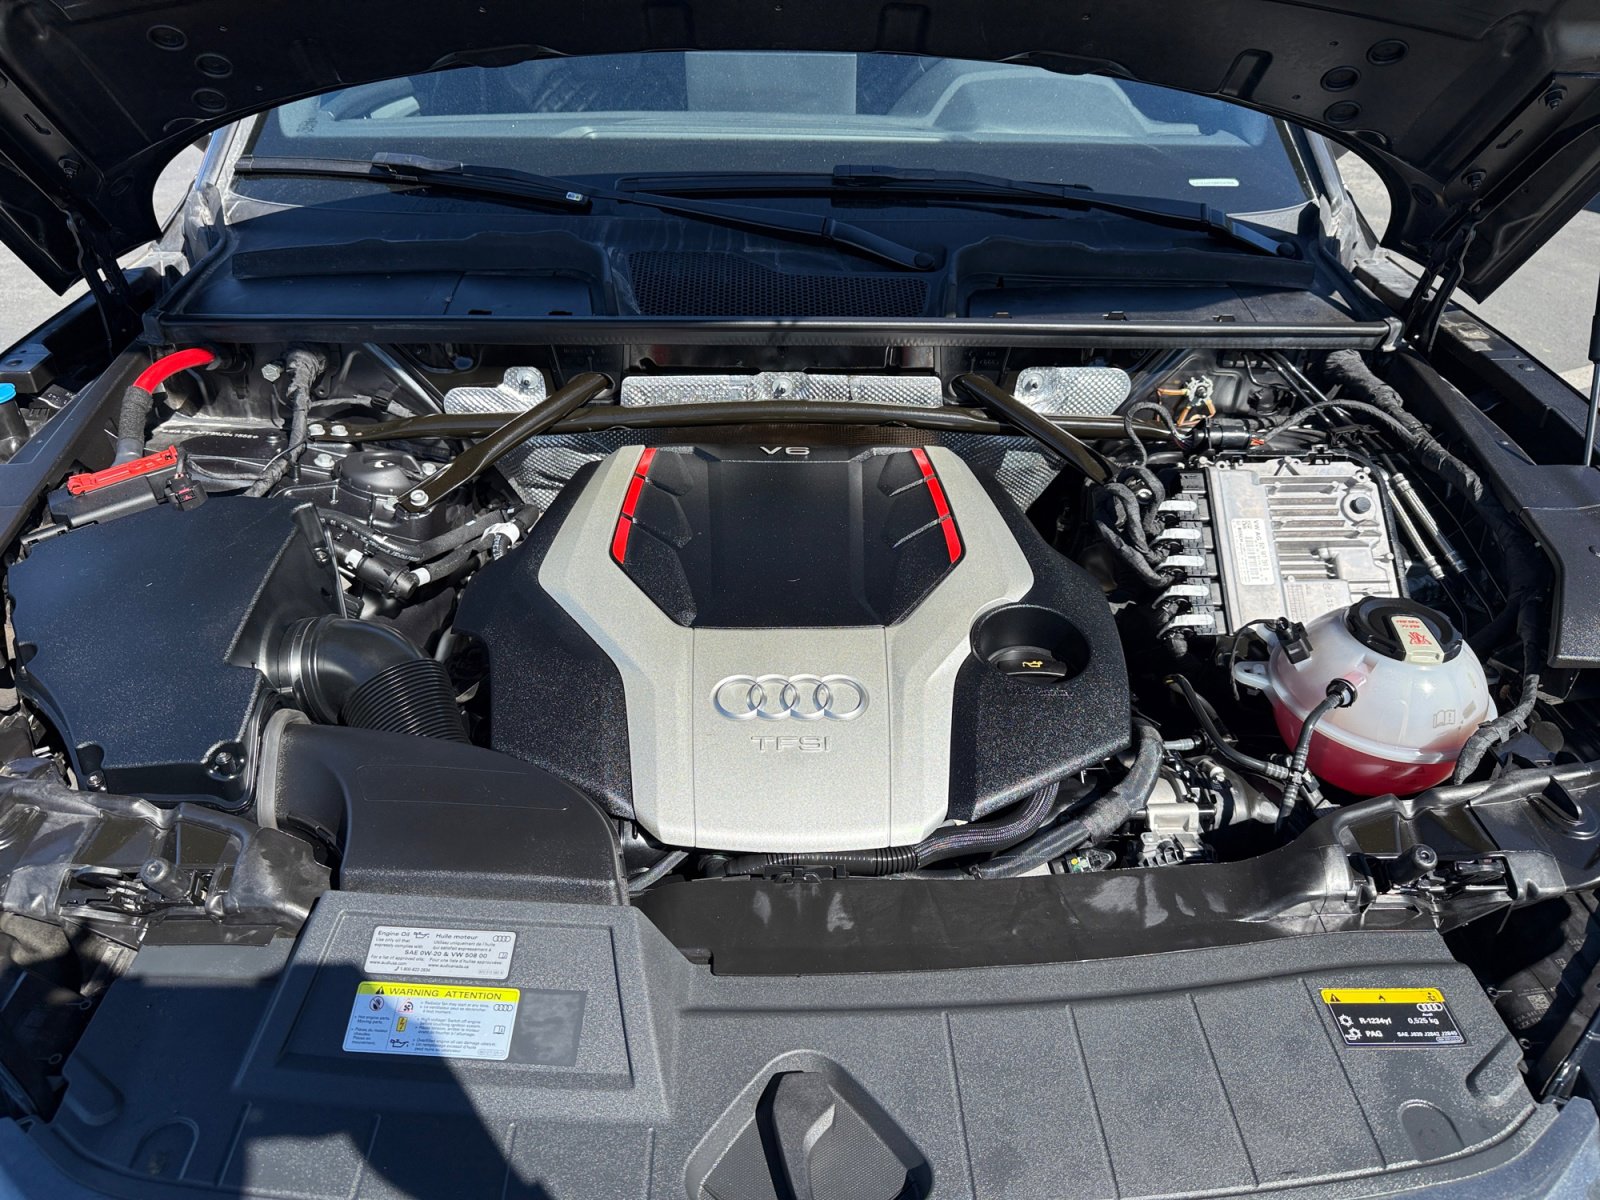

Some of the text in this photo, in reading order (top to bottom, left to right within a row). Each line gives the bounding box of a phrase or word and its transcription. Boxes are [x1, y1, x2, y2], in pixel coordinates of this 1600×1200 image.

[760, 446, 810, 455] V6
[750, 735, 830, 751] TFSI
[390, 987, 502, 1000] WARNING ATTENTION
[1358, 1017, 1440, 1026] R-1234yf 0,525 kg
[1364, 1030, 1383, 1038] PAG
